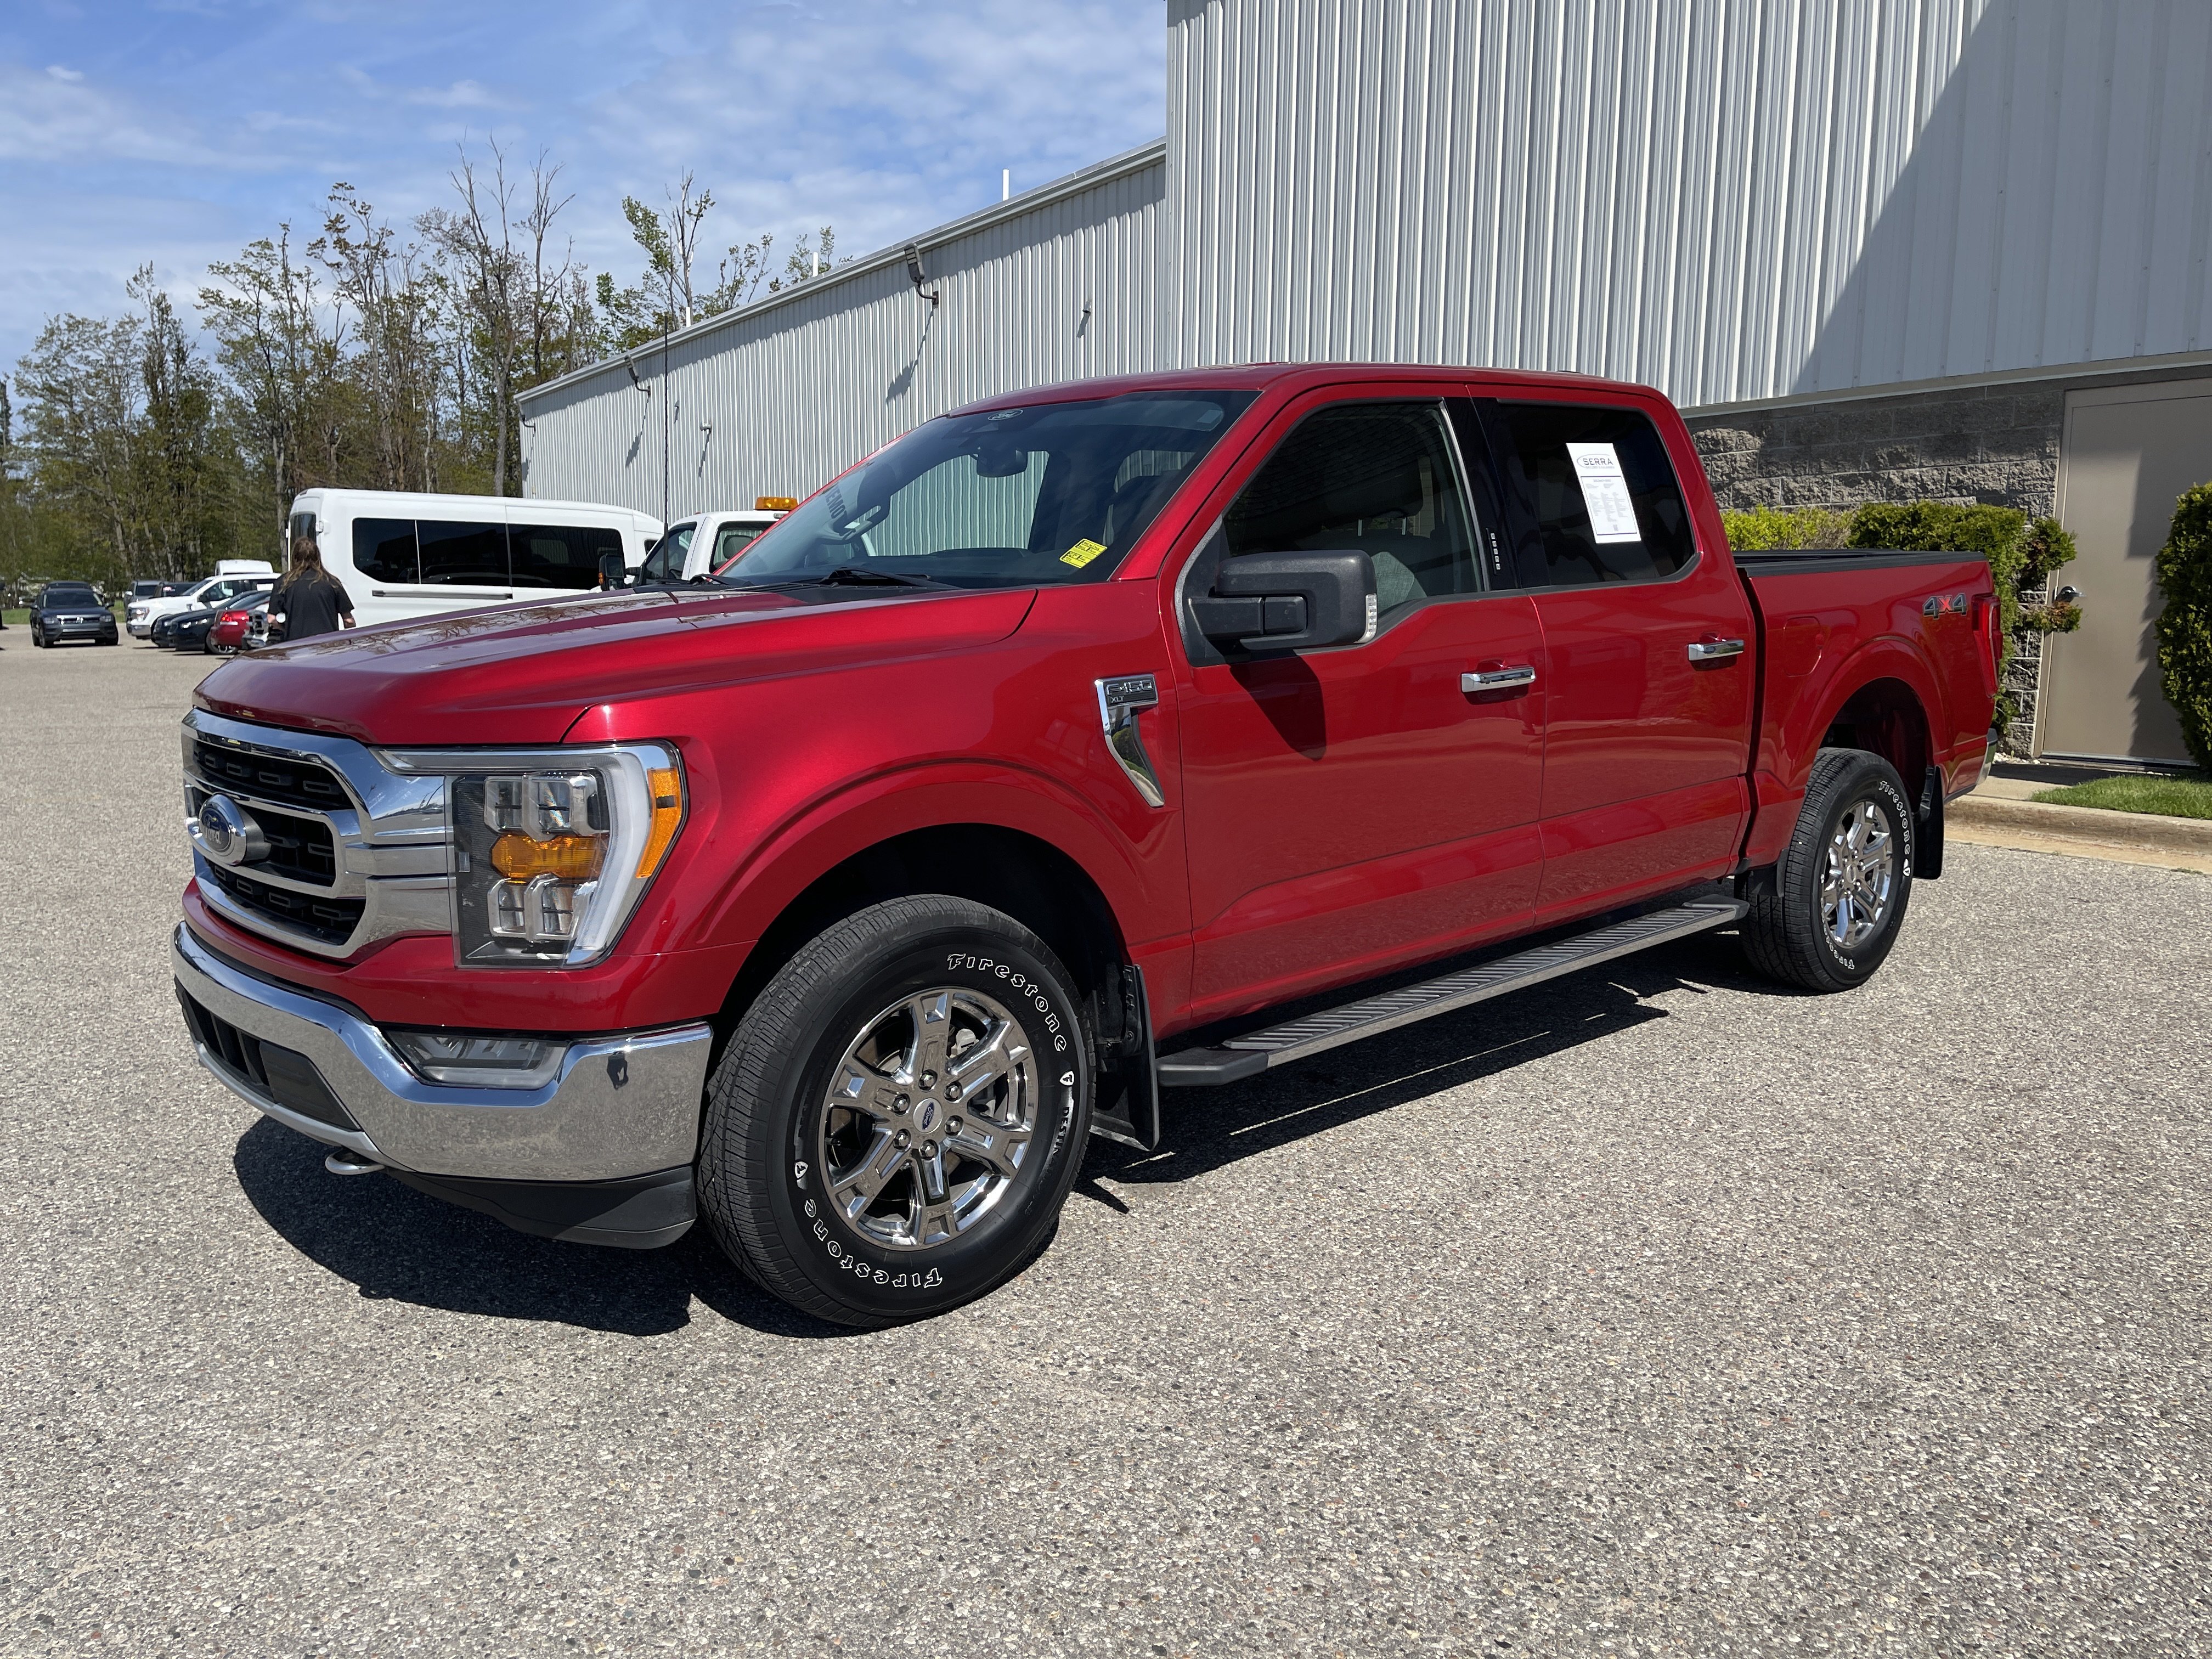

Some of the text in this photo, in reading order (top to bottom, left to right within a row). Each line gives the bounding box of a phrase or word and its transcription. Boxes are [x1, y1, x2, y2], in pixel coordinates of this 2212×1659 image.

[1106, 680, 1154, 695] F-150
[1878, 781, 1911, 855] Firestone
[947, 953, 1066, 1052] Firestone
[923, 1104, 933, 1126] Ford
[804, 1199, 943, 1288] Firestone
